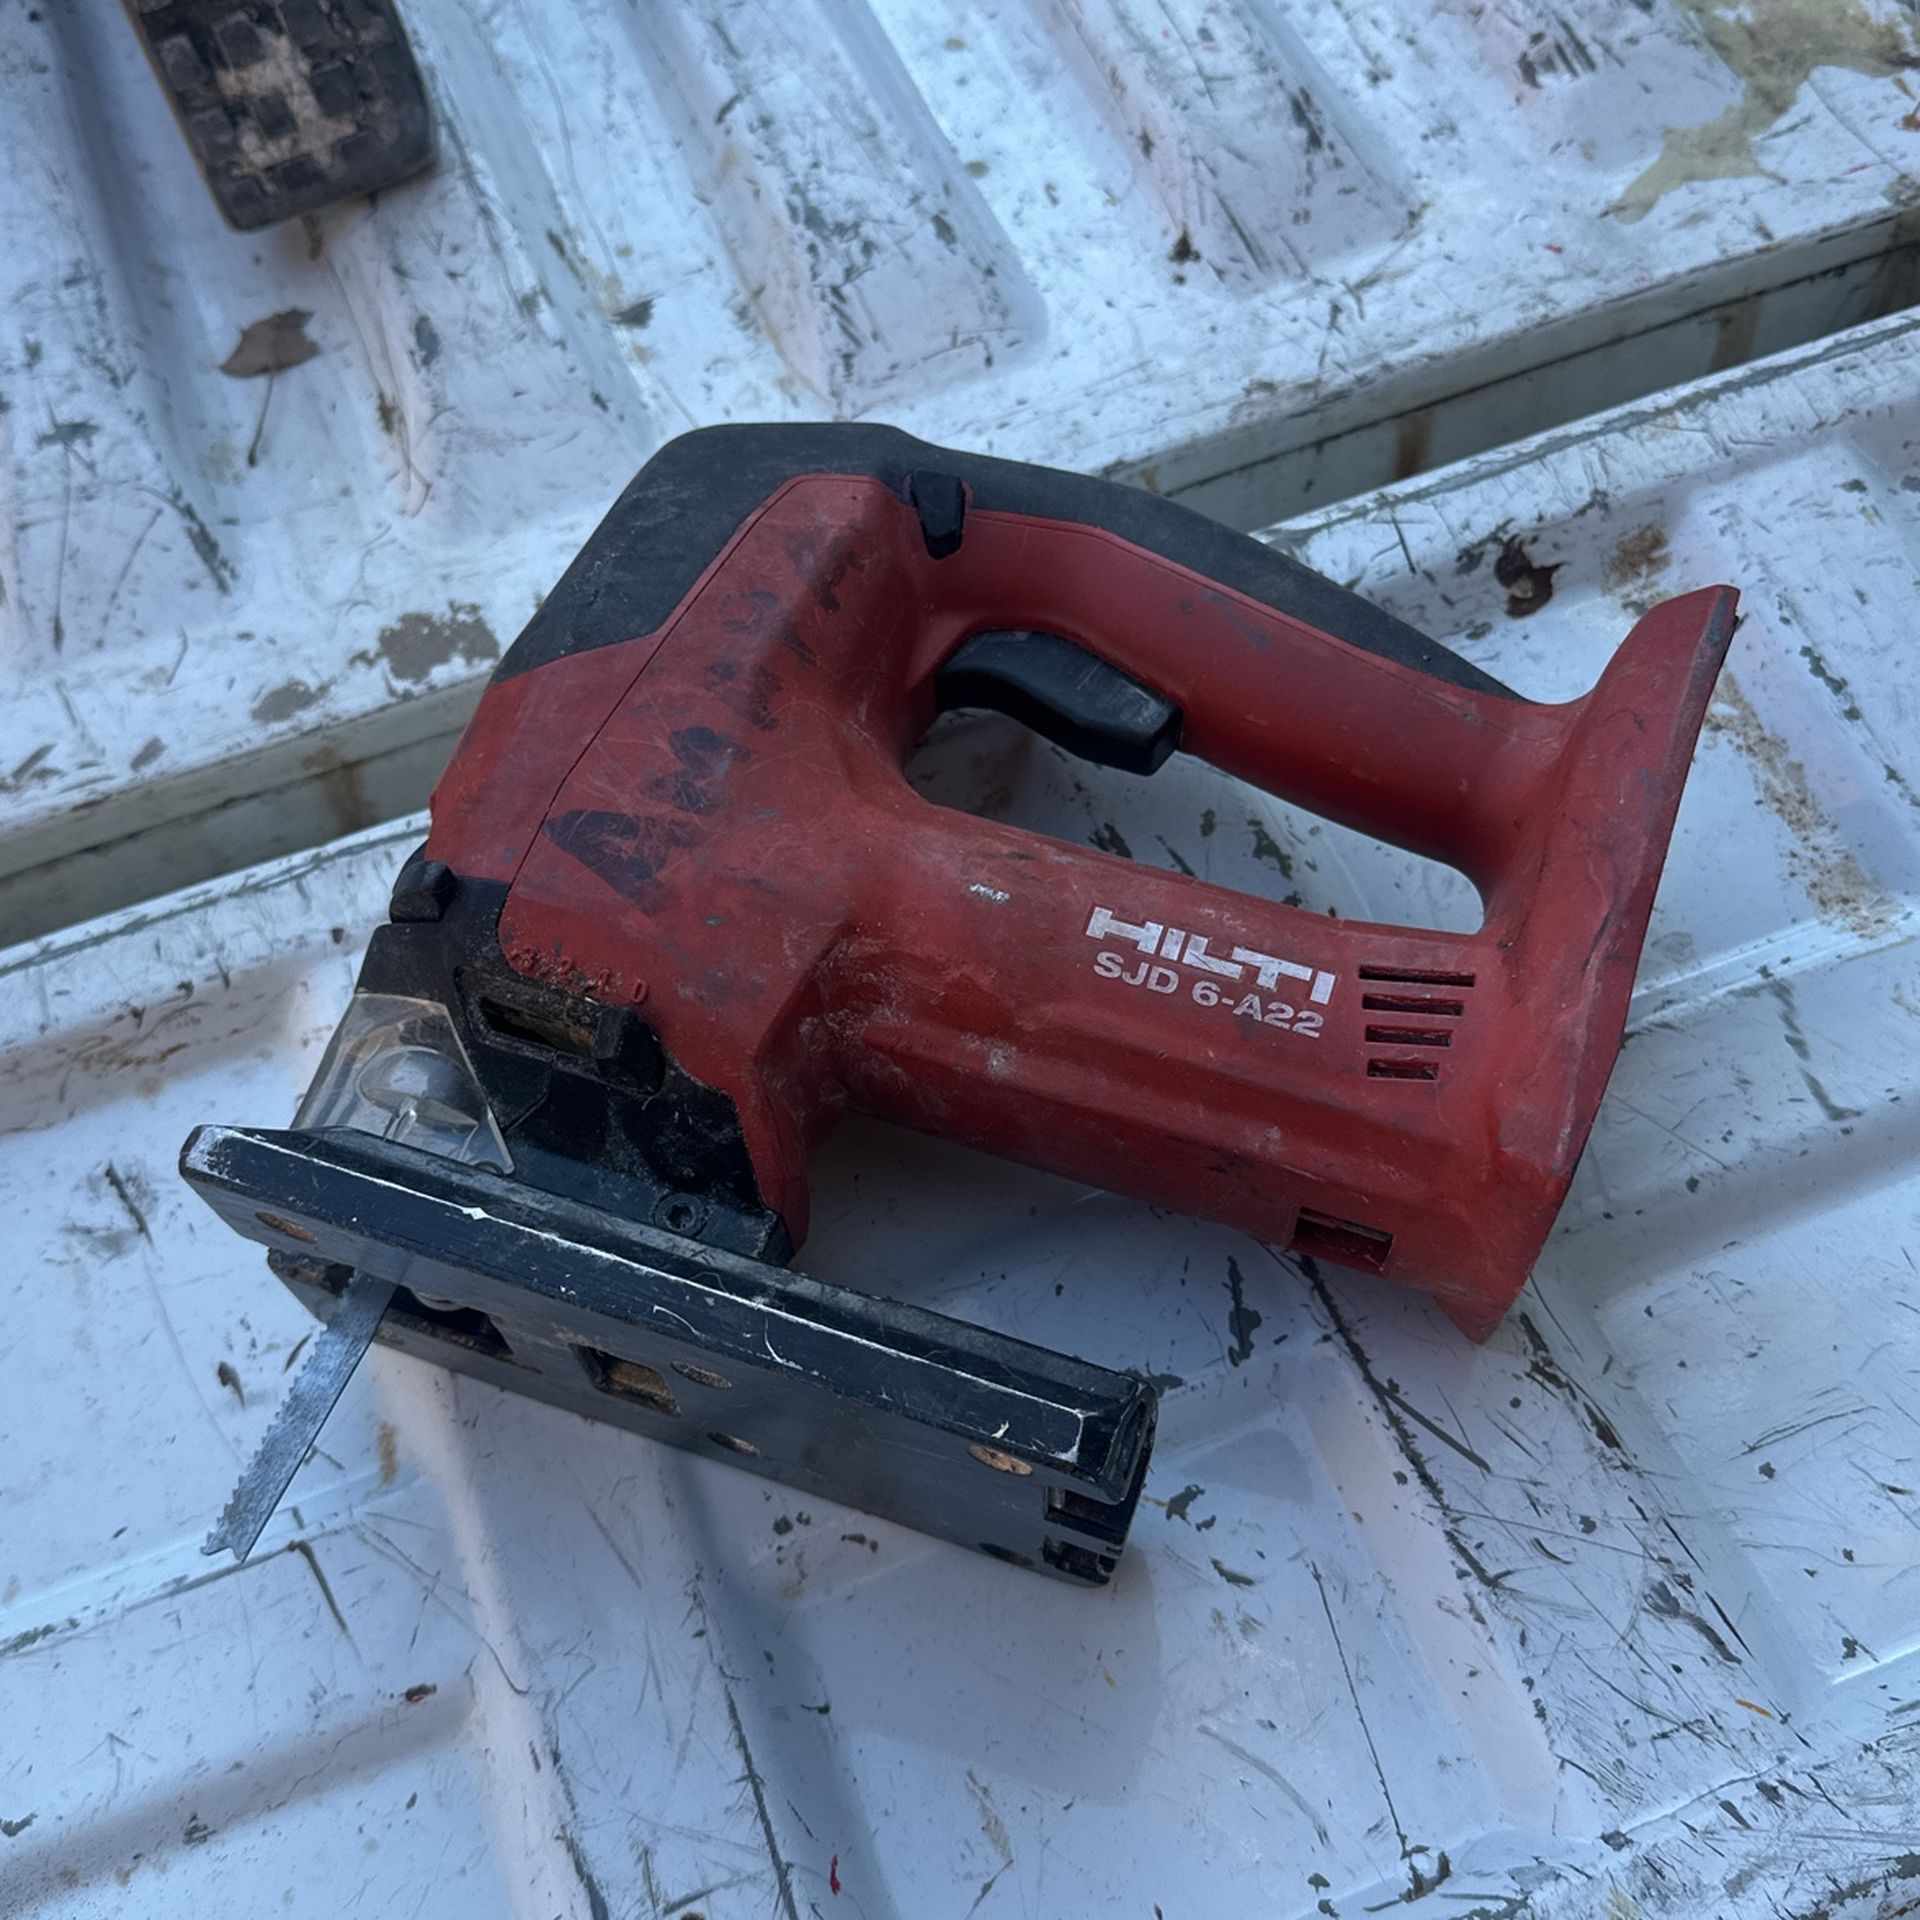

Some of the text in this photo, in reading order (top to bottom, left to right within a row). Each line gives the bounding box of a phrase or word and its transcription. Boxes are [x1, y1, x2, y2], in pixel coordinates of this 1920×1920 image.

[1085, 906, 1336, 1006] HILTI
[1093, 951, 1325, 1039] SJD 6-A22
